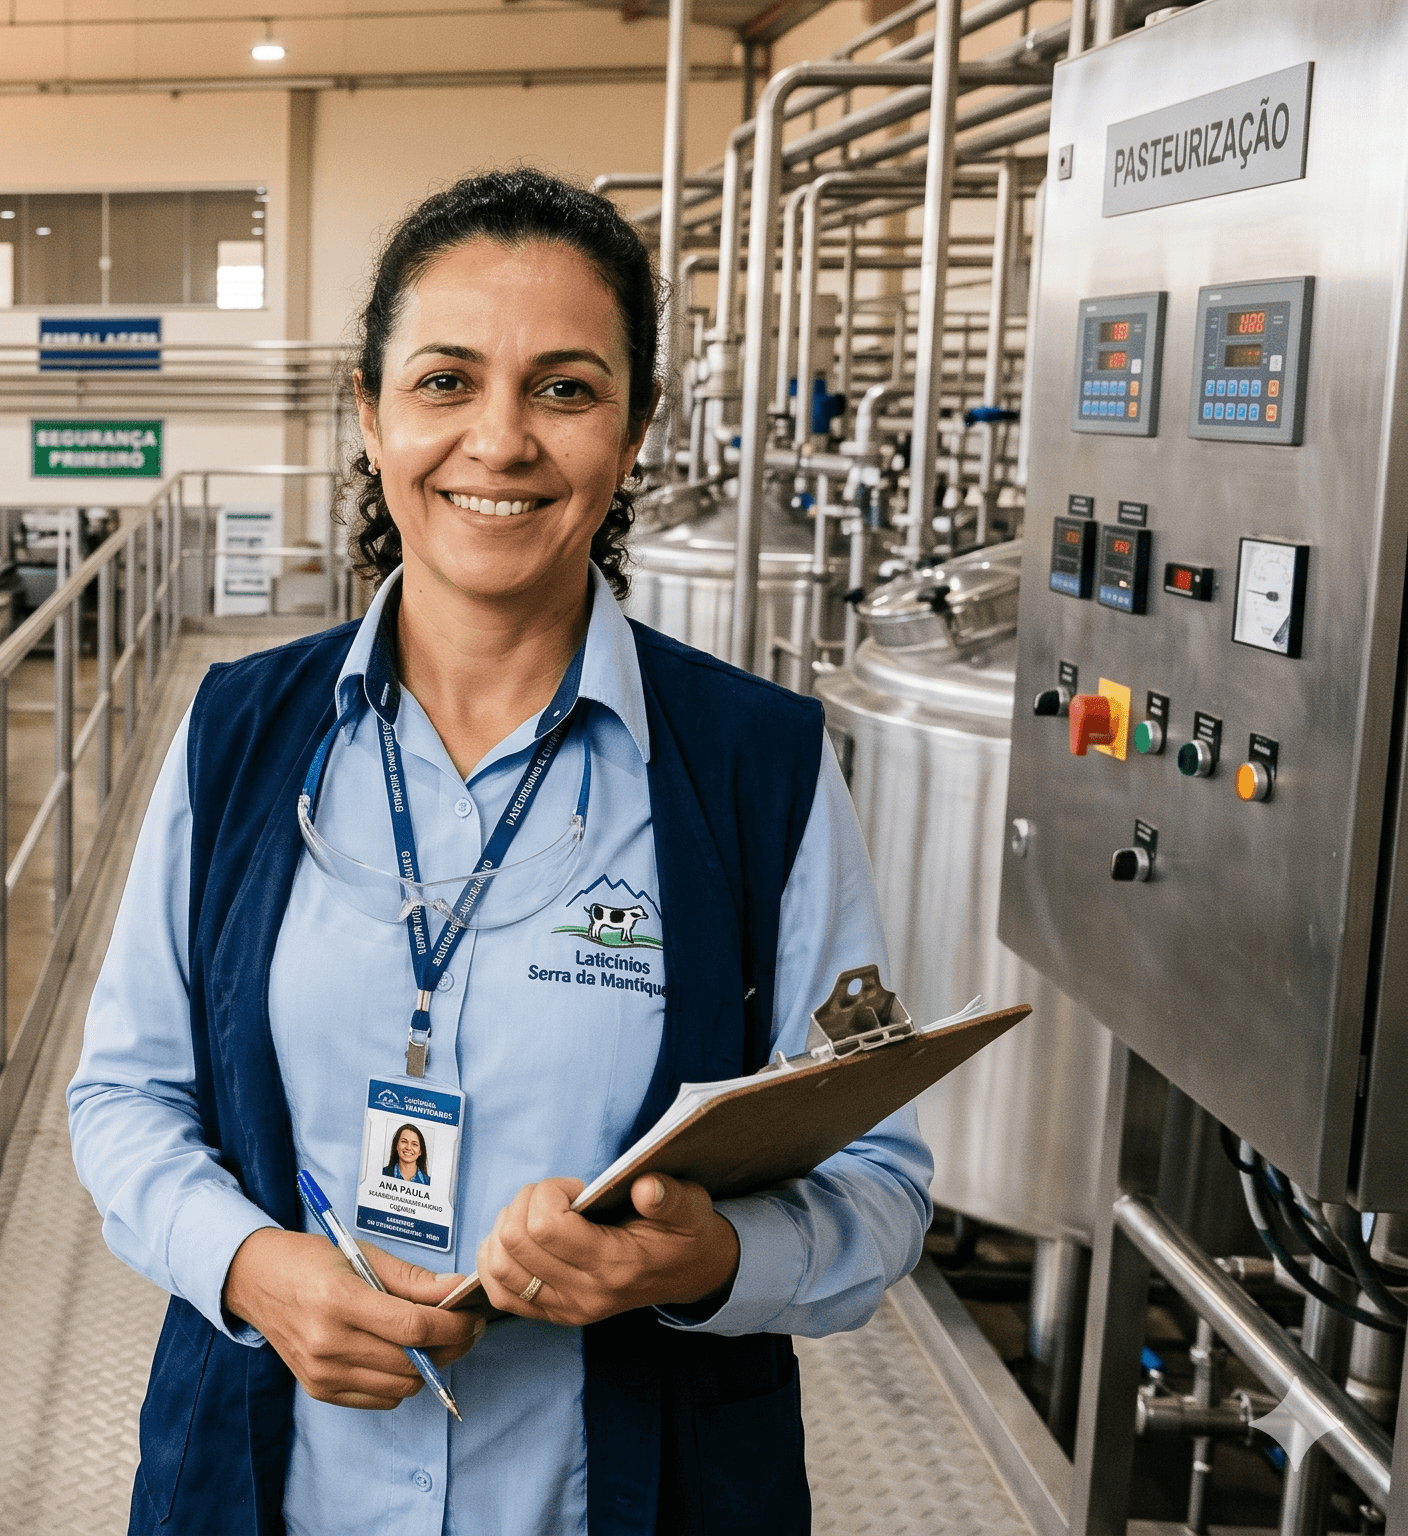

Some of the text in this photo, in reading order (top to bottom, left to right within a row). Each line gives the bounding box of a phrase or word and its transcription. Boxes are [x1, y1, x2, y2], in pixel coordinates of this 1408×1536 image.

[1114, 96, 1290, 188] PASTEURIZAÇÃO
[36, 429, 157, 450] SEGURANÇA
[49, 450, 145, 468] PRIMEIRO
[575, 950, 651, 975] Laticínios
[528, 965, 571, 984] Serra
[576, 969, 596, 985] da
[379, 1181, 430, 1200] ANA PAULA
